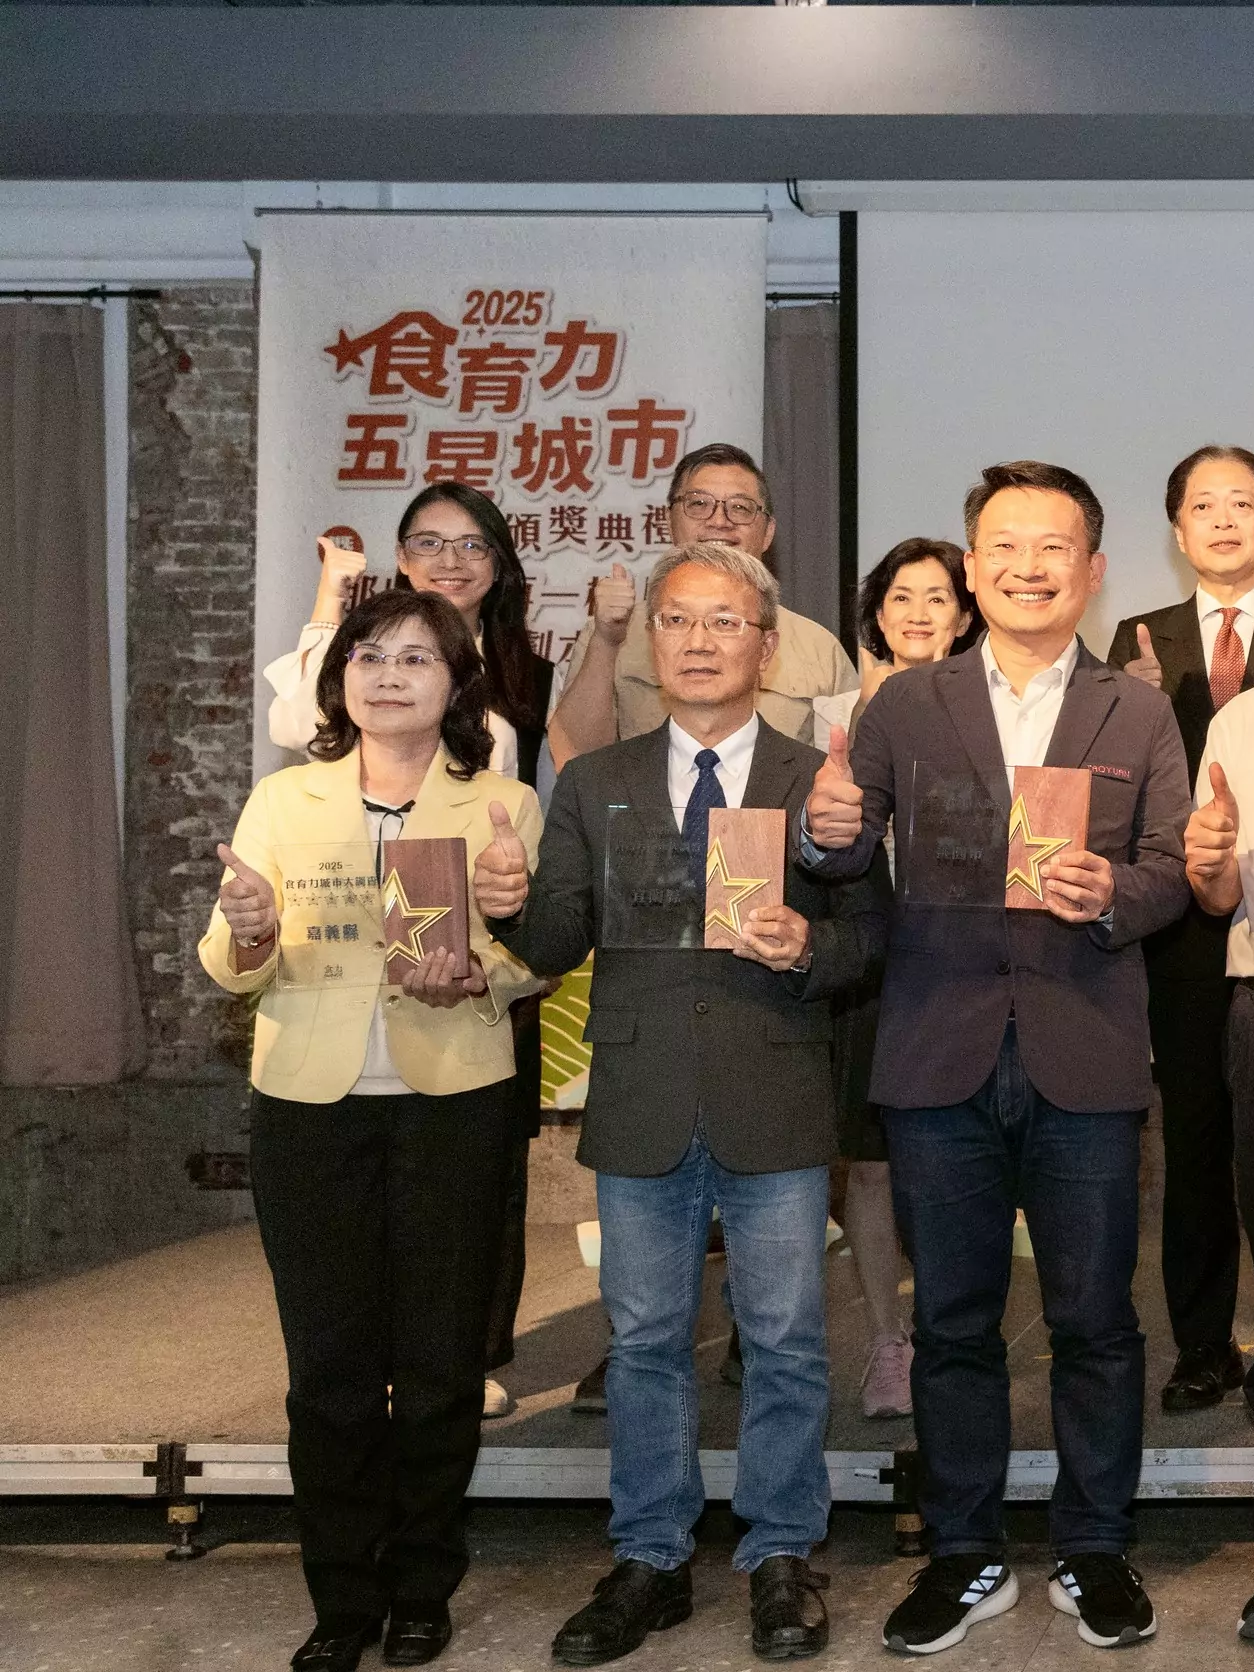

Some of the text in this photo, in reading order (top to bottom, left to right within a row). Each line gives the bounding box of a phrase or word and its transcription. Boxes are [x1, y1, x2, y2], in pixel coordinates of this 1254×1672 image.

[462, 289, 545, 326] 2025
[362, 311, 618, 414] 食育力
[338, 399, 687, 500] 五星城市
[319, 861, 343, 871] 2025
